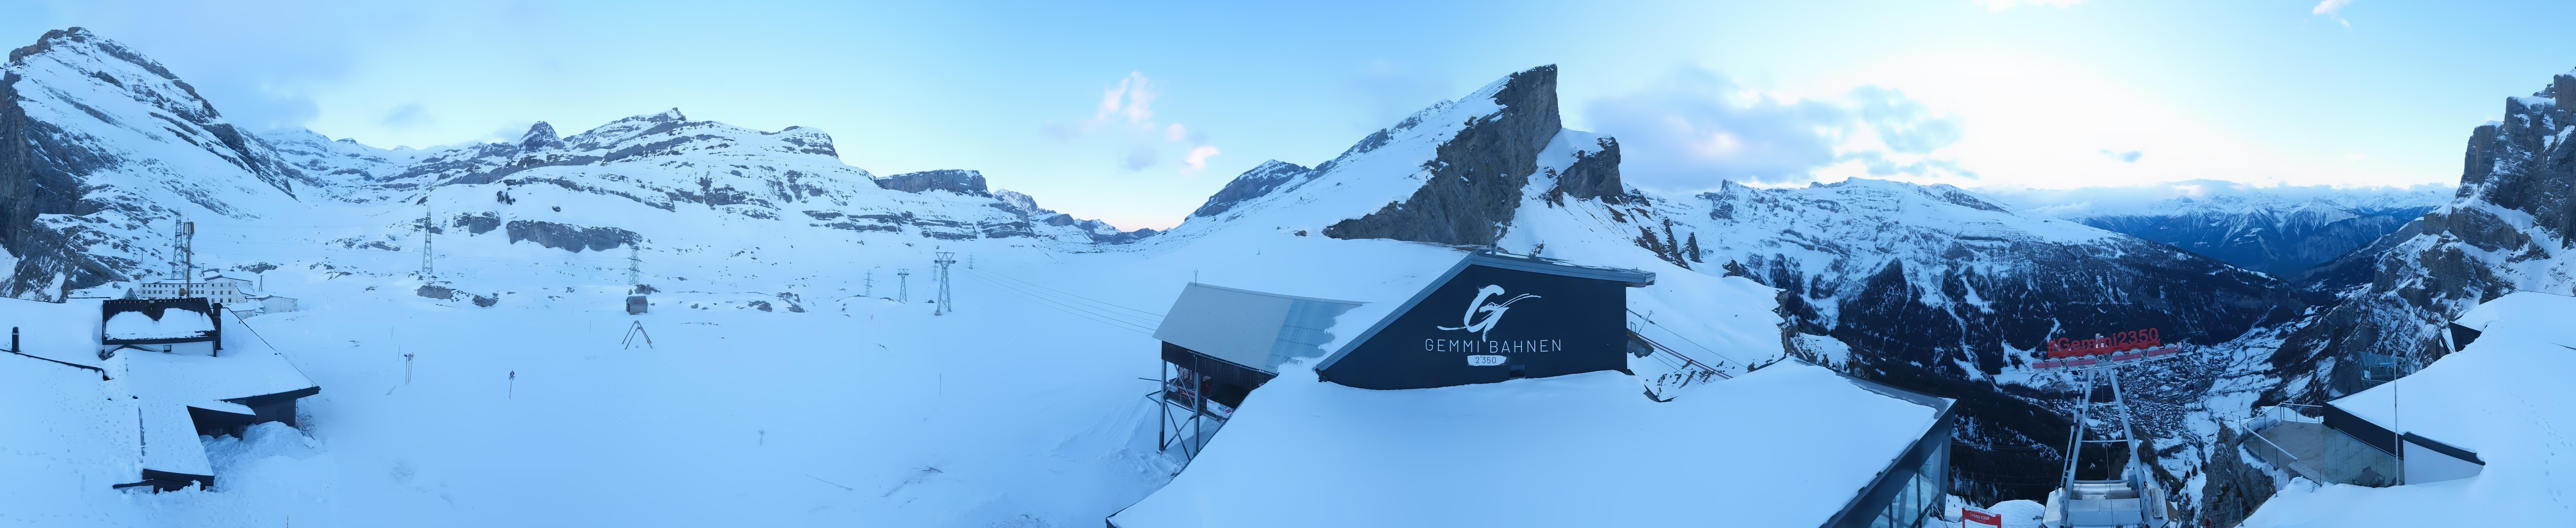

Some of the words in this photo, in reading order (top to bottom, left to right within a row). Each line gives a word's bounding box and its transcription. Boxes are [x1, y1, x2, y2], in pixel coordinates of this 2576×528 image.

[1425, 339, 1479, 352] GEMMI
[1490, 339, 1561, 353] BAHNEN
[2047, 328, 2159, 352] #Gemmi2350
